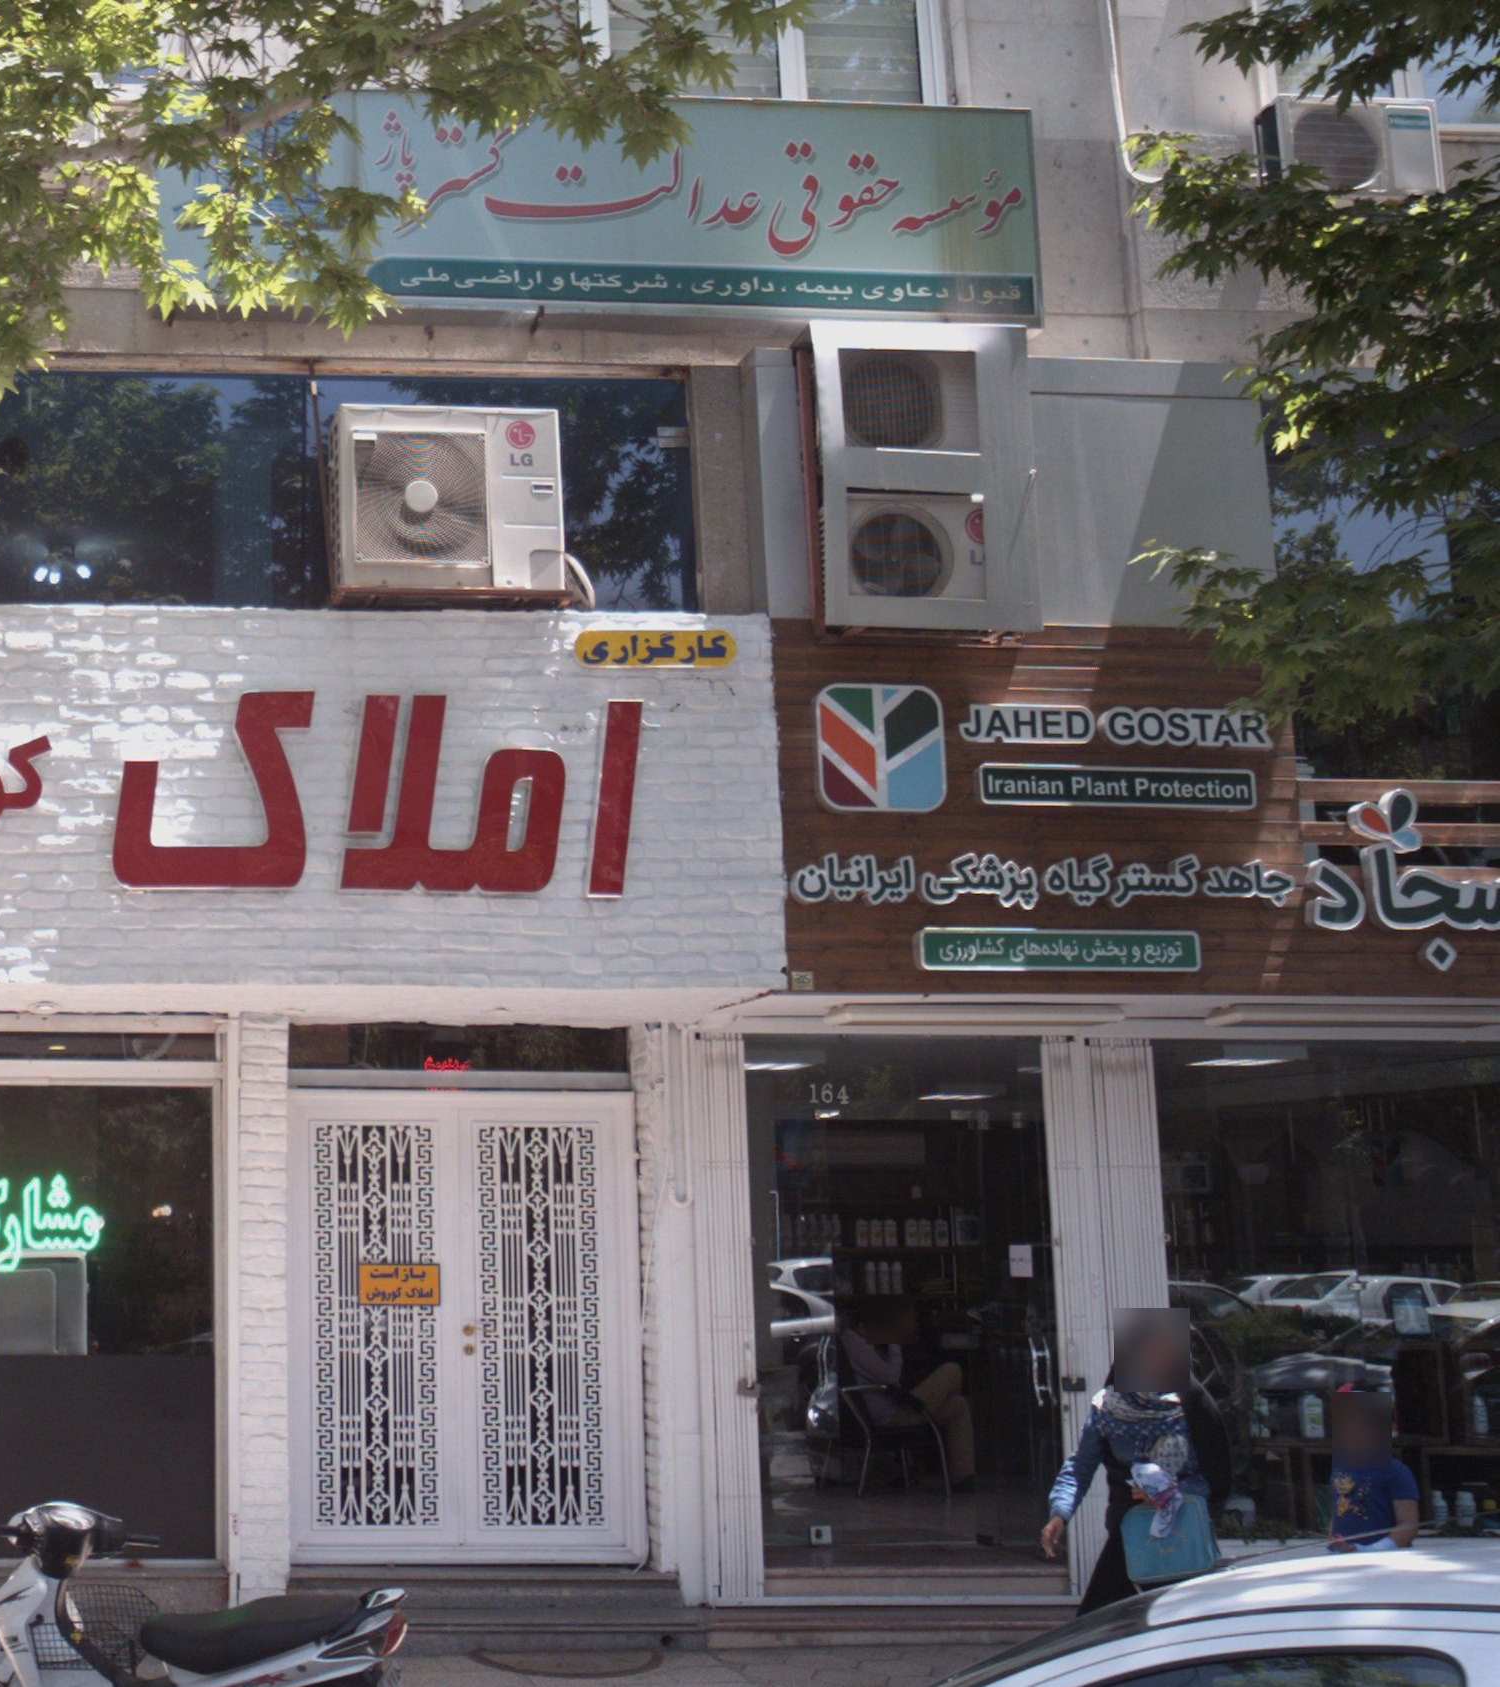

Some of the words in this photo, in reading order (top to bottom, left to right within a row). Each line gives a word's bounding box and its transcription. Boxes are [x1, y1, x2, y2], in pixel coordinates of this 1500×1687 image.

[484, 145, 761, 225] عدالت
[768, 142, 901, 256] حقوقی
[400, 268, 450, 287] ملی
[454, 269, 543, 290] اراضی
[551, 277, 563, 289] و
[691, 277, 774, 296] داوری
[796, 281, 853, 301] بیمه
[862, 282, 948, 301] دعاوی
[959, 284, 1021, 302] قبول
[510, 453, 533, 467] LG
[583, 634, 727, 664] کارگزاری
[962, 706, 1092, 742] JAHED
[1107, 708, 1266, 746] GOSTAR
[112, 690, 644, 898] املاک
[987, 773, 1065, 796] Iranian
[1070, 774, 1131, 797] Plant
[1134, 776, 1250, 799] Protection
[798, 855, 914, 902] ایرانیان
[924, 855, 1035, 908] پزشکی
[1048, 855, 1114, 906] گیاه
[1117, 857, 1198, 906] گستر
[1207, 862, 1293, 902] جاهد
[939, 938, 1005, 963] کشاورزی
[1084, 939, 1128, 965] پخش
[1132, 947, 1142, 962] و
[1143, 941, 1183, 962] توزیع
[809, 1083, 849, 1105] 164
[370, 1266, 399, 1279] است
[401, 1266, 426, 1283] باز
[366, 1287, 402, 1302] کوروش
[405, 1287, 434, 1299] املاک
